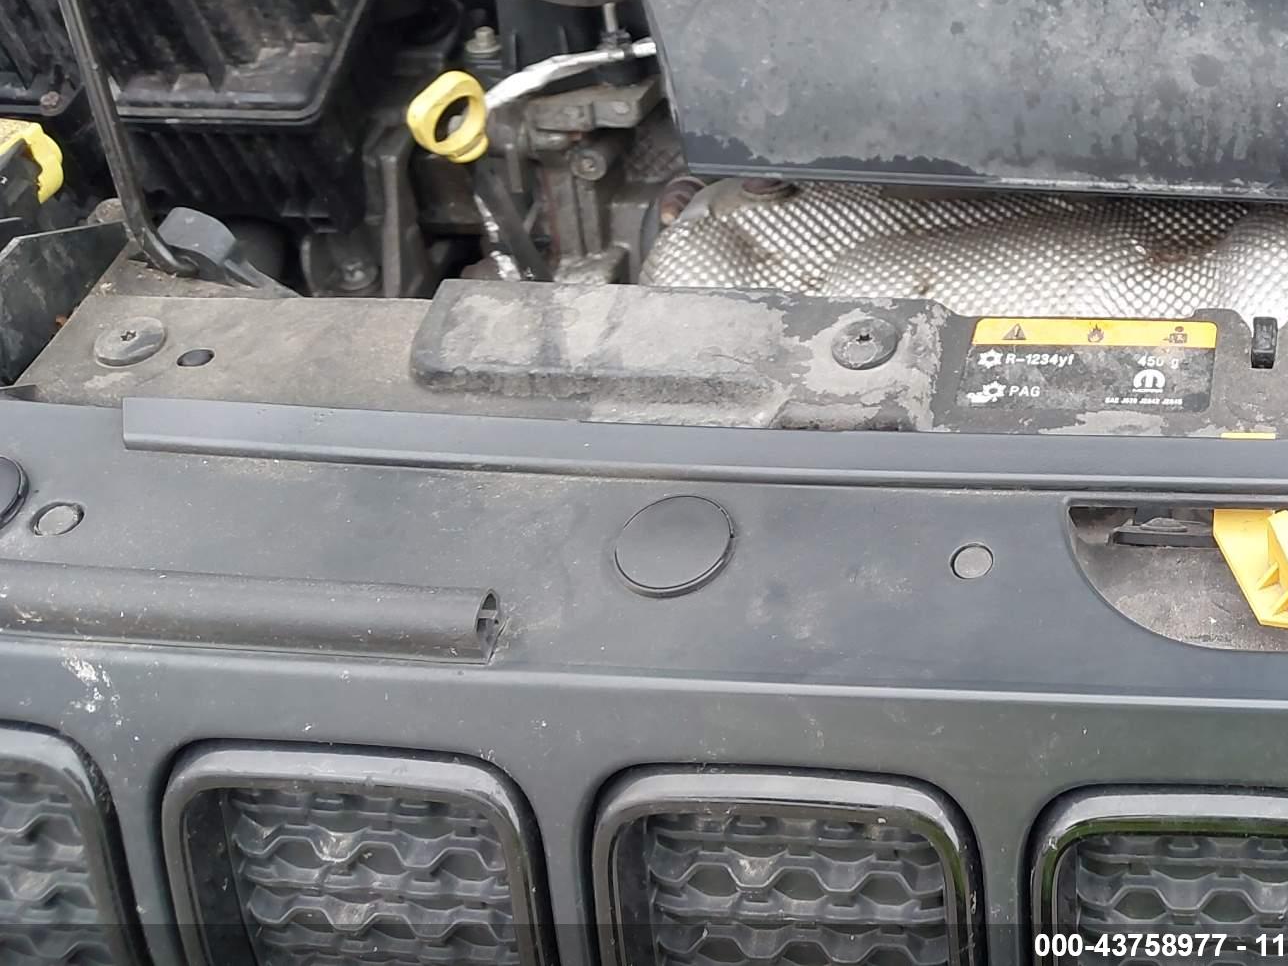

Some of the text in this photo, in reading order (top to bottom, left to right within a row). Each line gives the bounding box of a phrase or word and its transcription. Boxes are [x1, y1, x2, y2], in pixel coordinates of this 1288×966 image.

[1005, 352, 1075, 367] R-1234yf
[1136, 355, 1164, 368] 450
[1008, 385, 1041, 398] PAG
